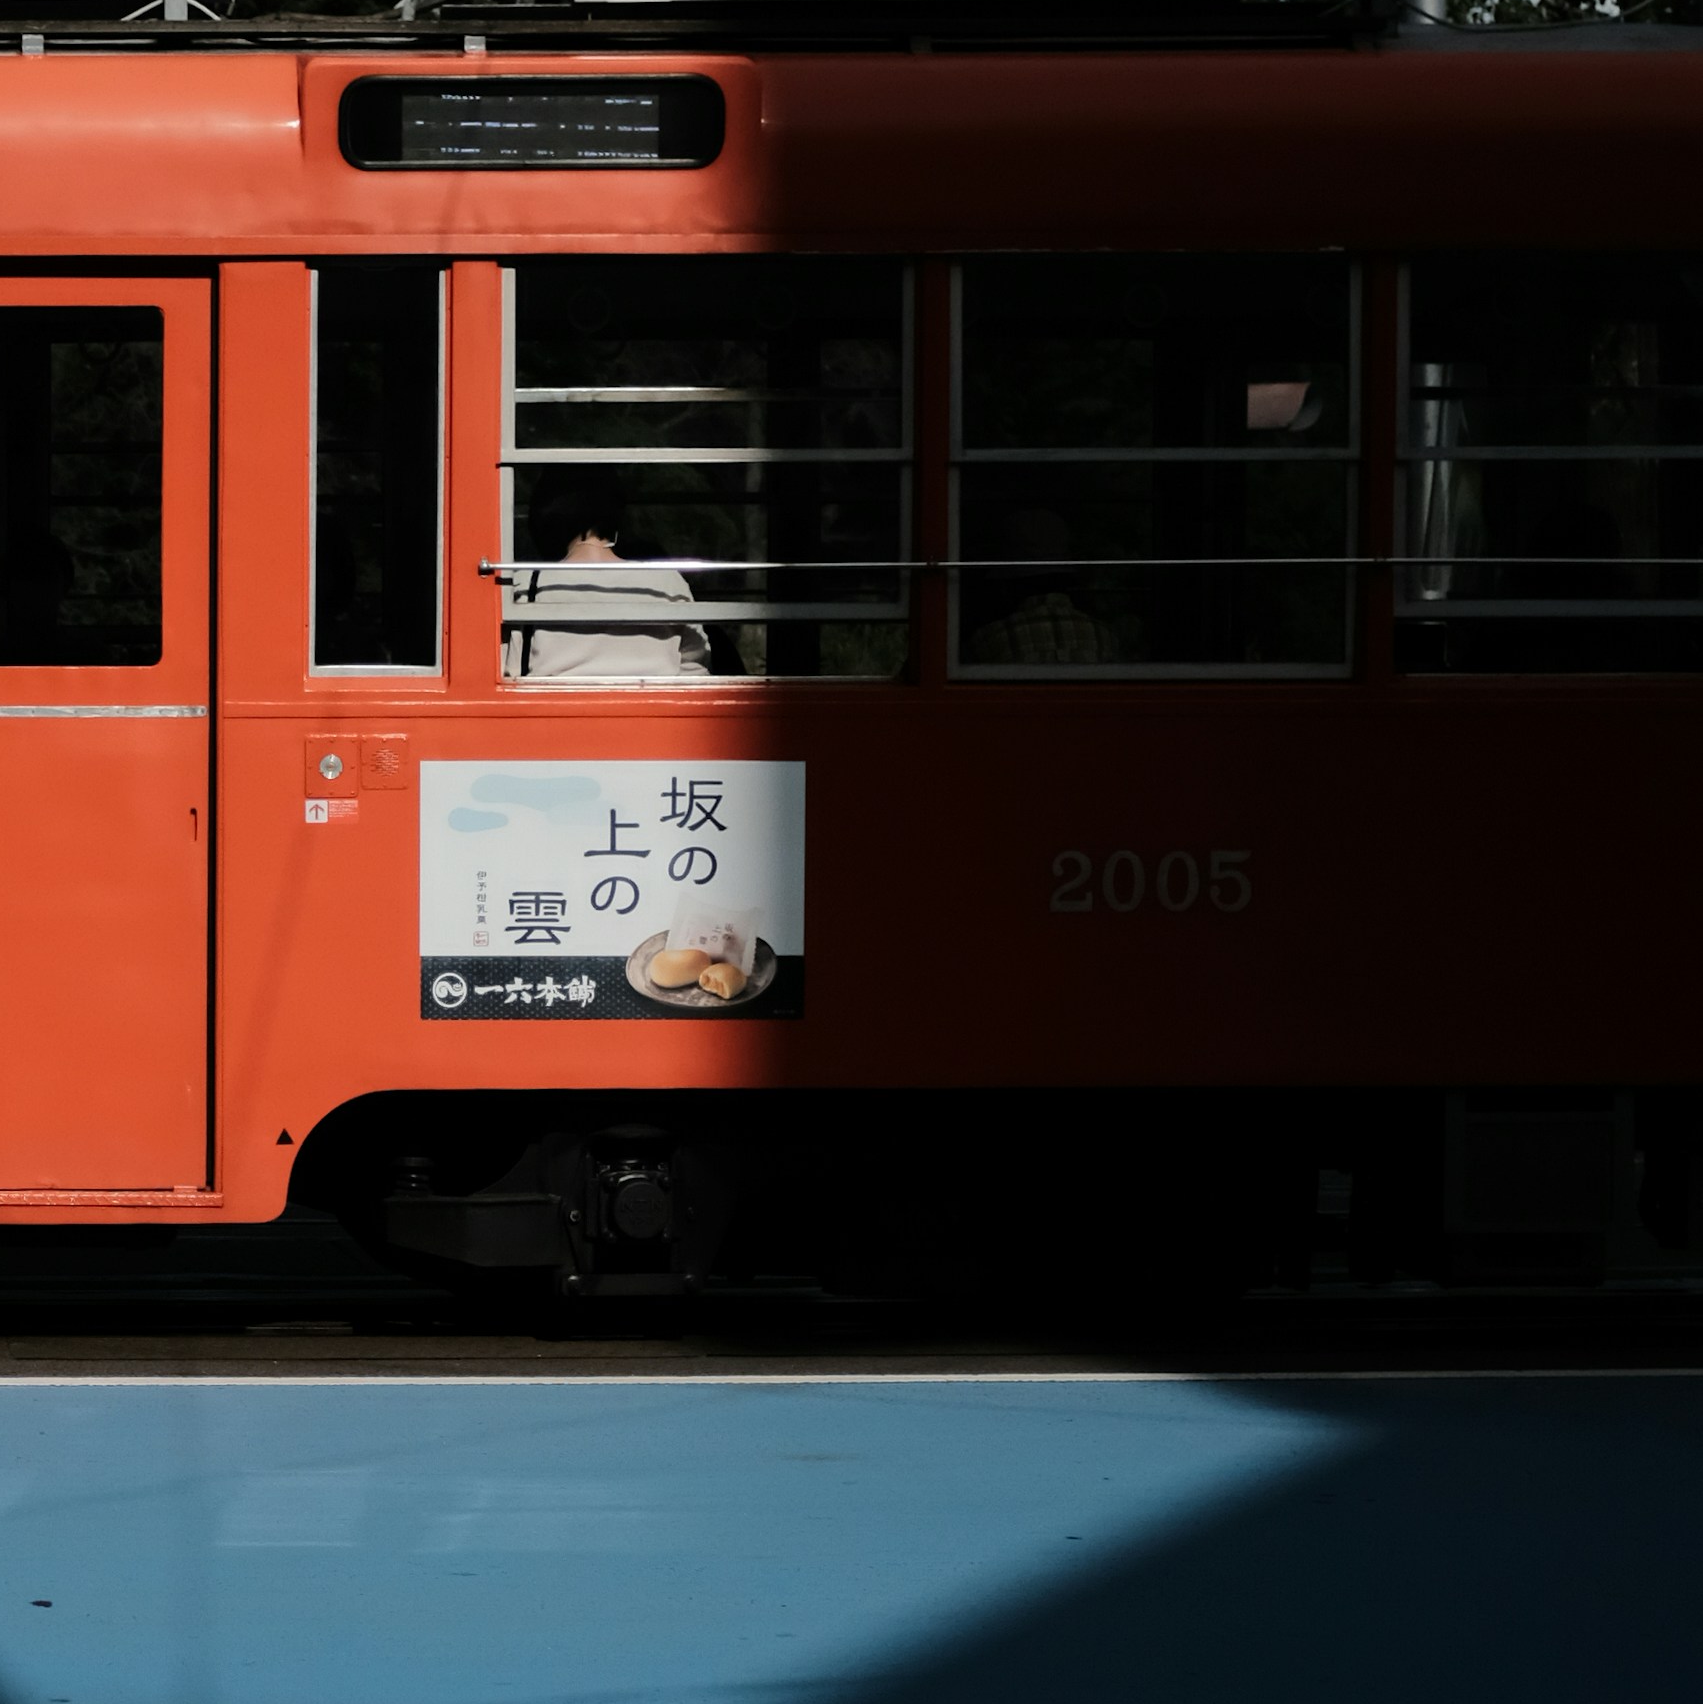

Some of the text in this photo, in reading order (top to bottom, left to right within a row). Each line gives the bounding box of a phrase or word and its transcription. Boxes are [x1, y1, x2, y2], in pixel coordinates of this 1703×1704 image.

[583, 808, 652, 915] 上の
[659, 776, 728, 885] 坂の
[504, 890, 572, 945] 雲
[1048, 849, 1253, 913] 2005
